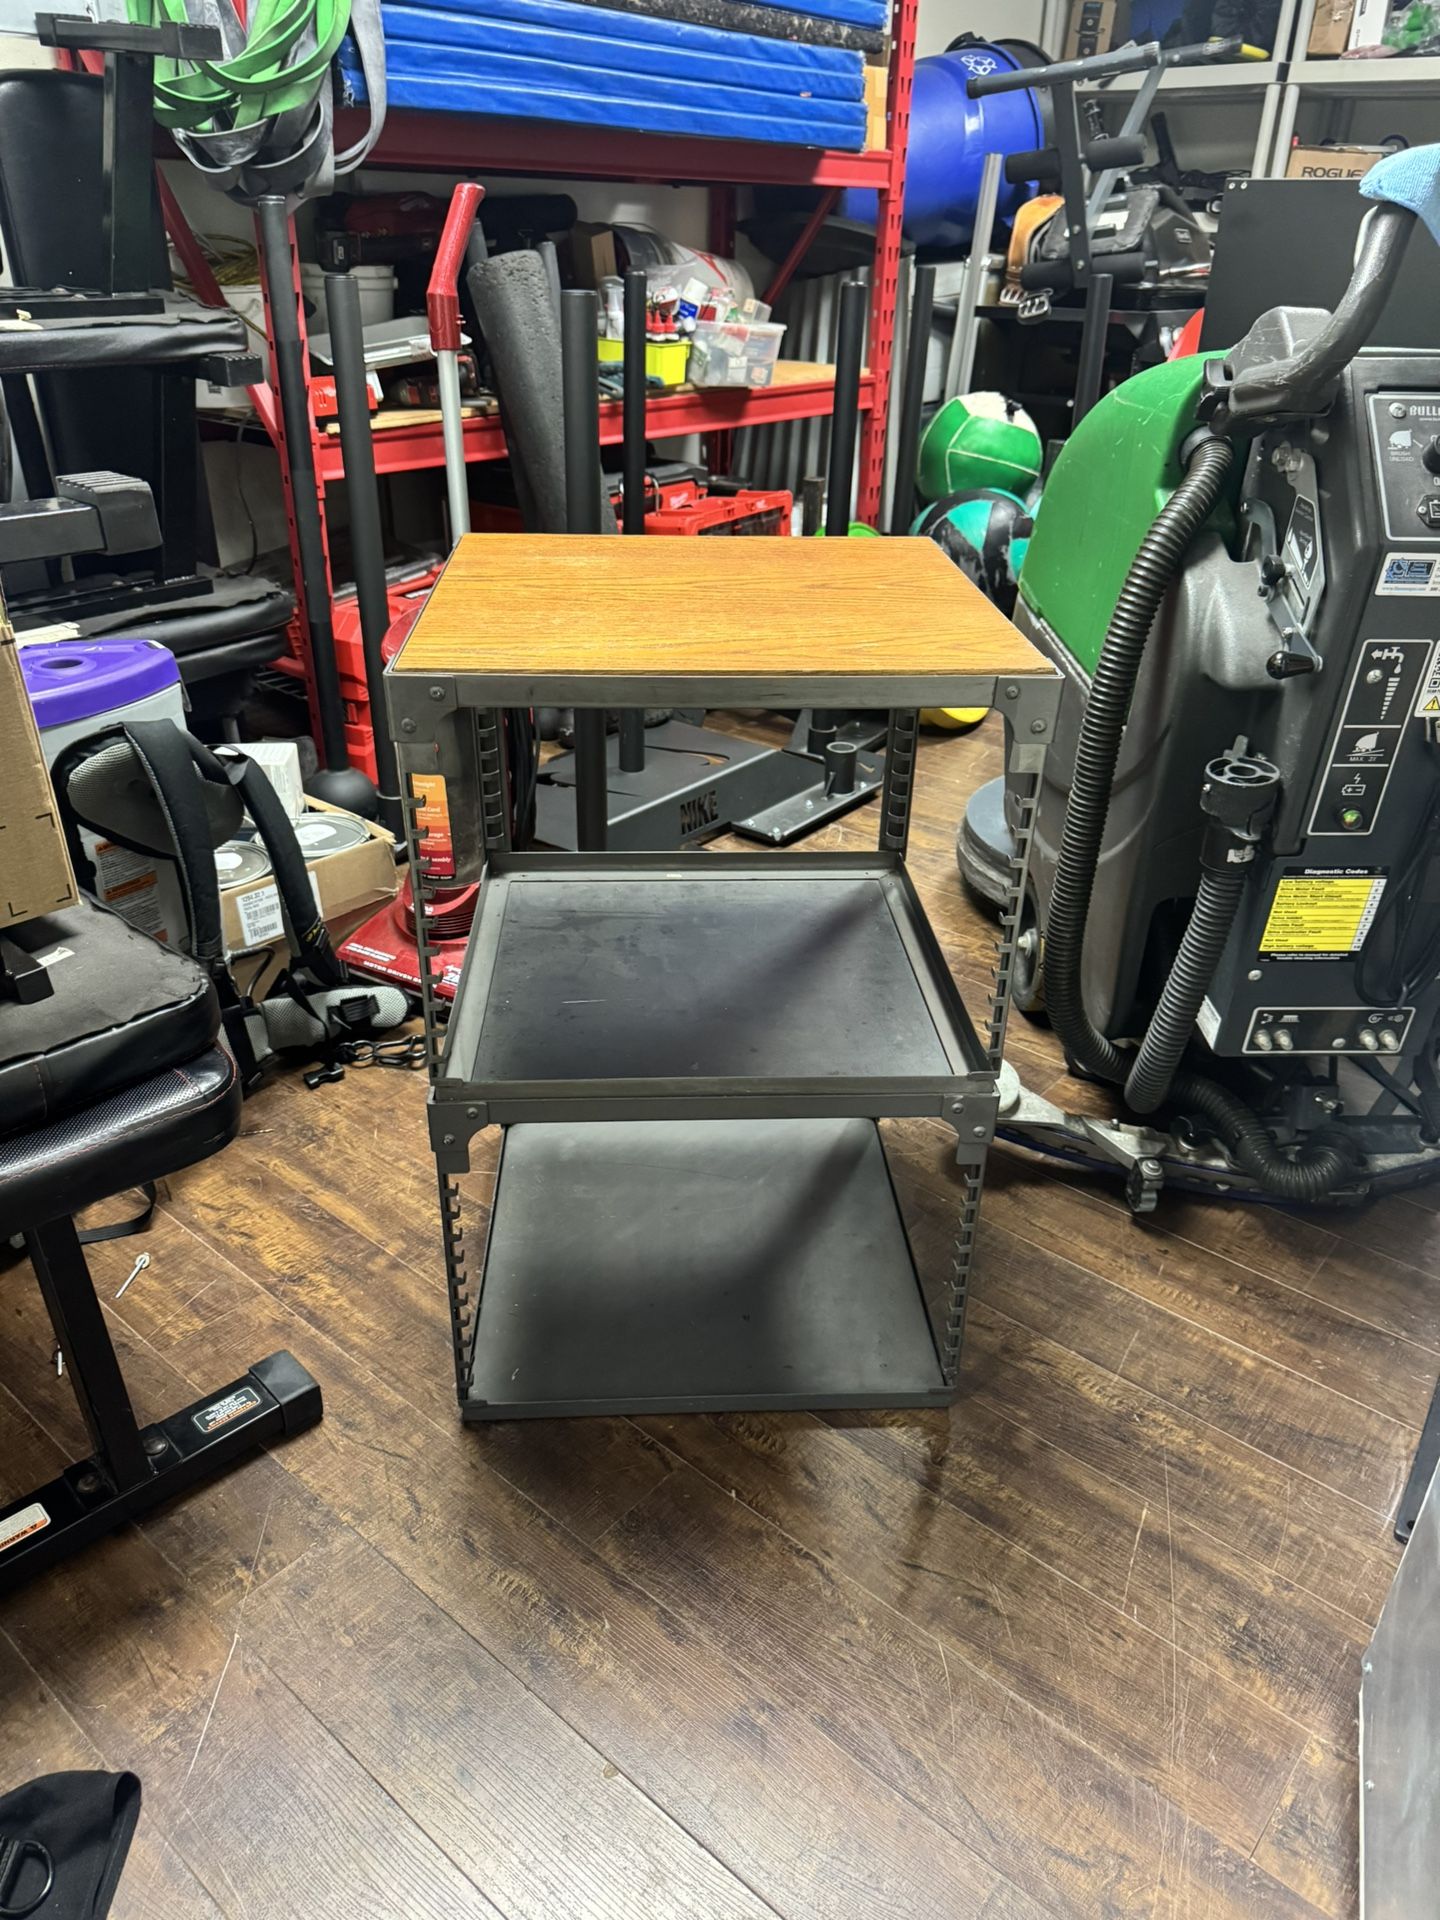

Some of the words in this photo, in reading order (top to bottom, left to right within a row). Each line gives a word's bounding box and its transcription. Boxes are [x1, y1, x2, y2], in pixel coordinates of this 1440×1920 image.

[1301, 166, 1364, 178] ROGUE
[1409, 405, 1440, 416] BULL
[680, 790, 718, 835] NIKE
